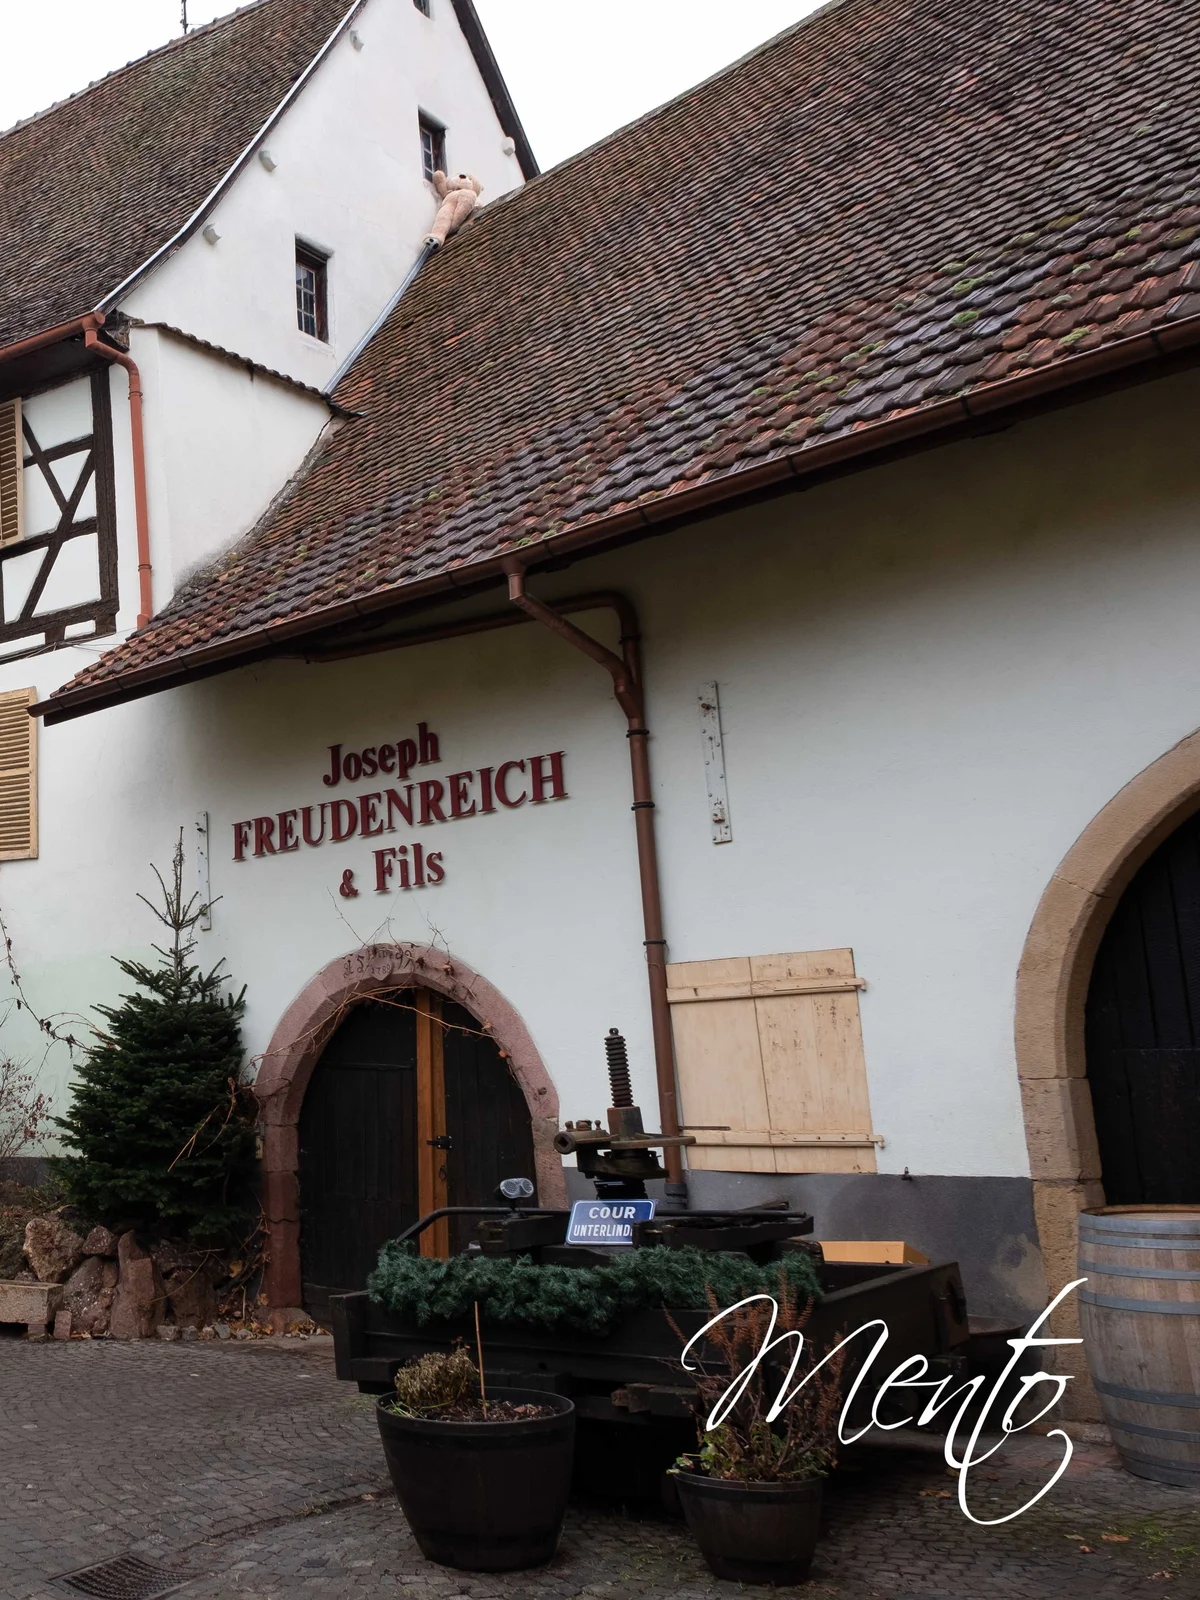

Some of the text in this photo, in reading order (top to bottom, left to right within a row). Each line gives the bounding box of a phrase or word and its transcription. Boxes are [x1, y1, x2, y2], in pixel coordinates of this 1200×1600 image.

[322, 722, 441, 786] Joseph
[231, 750, 570, 862] FREUDENREICH
[339, 842, 445, 898] & Fils
[589, 1206, 636, 1219] COUR
